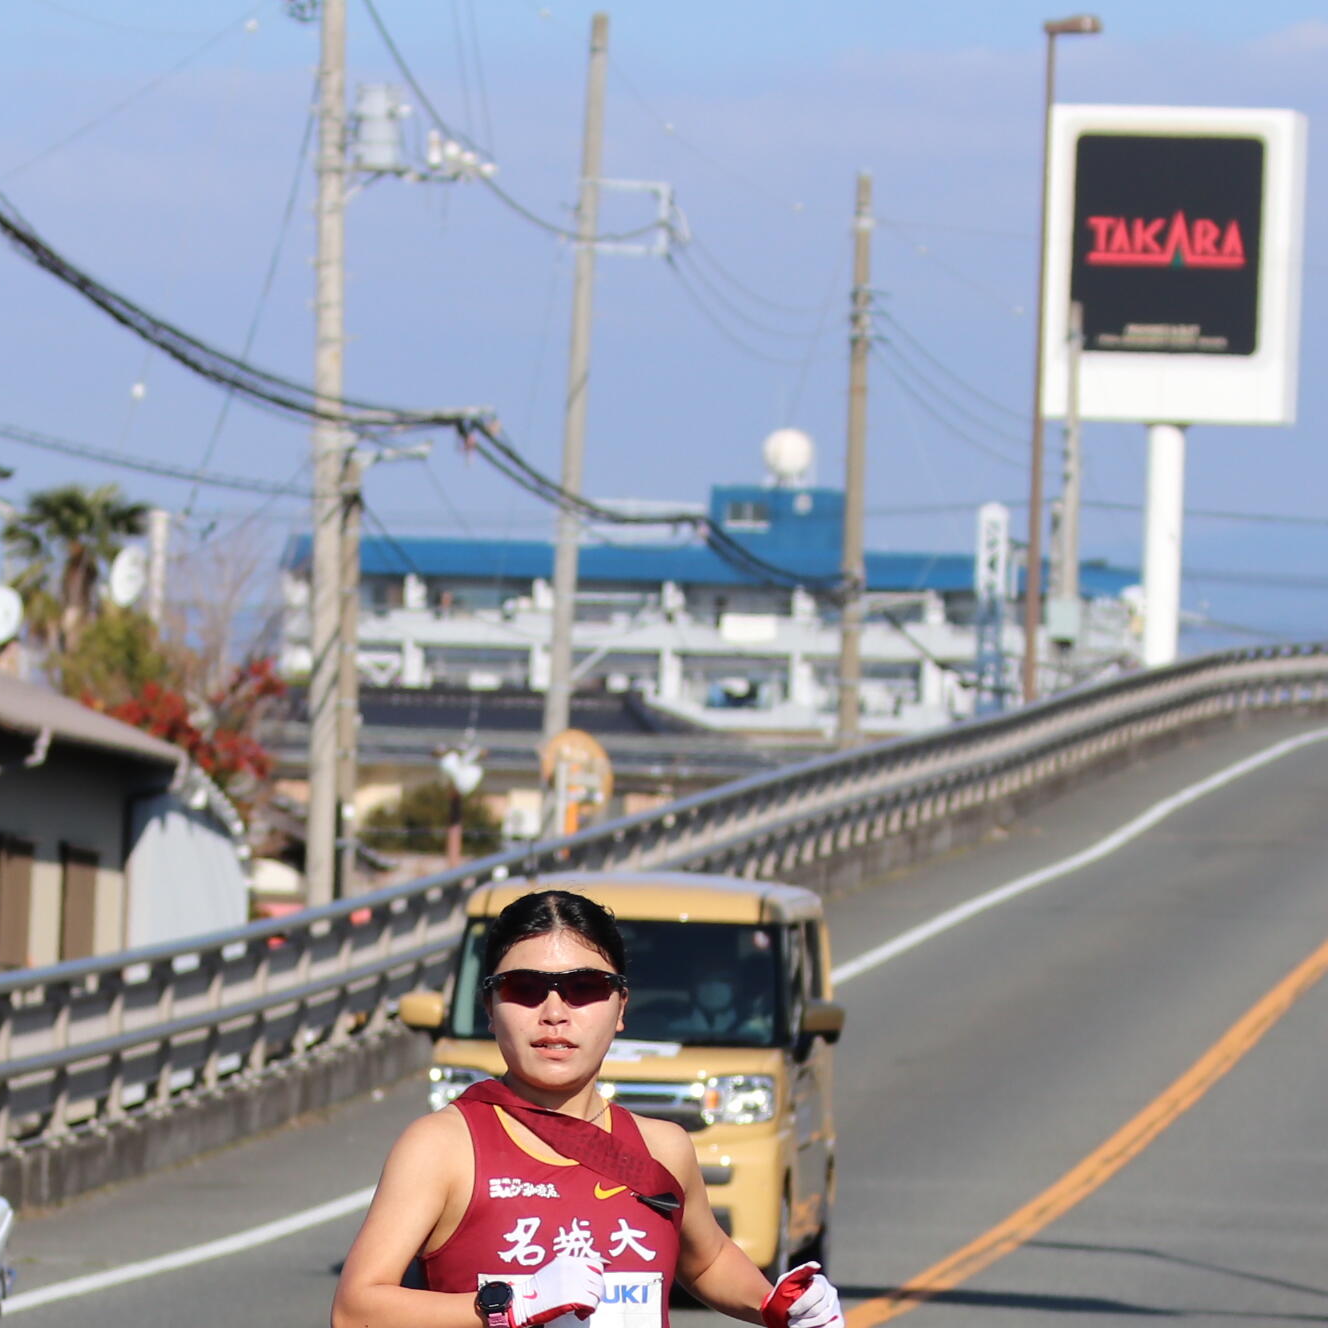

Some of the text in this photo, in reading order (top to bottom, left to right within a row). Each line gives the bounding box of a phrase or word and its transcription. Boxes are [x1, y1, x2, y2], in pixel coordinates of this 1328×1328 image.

[1086, 210, 1246, 265] TAKARA
[497, 1216, 656, 1266] 名城大
[602, 1284, 649, 1304] UKI
